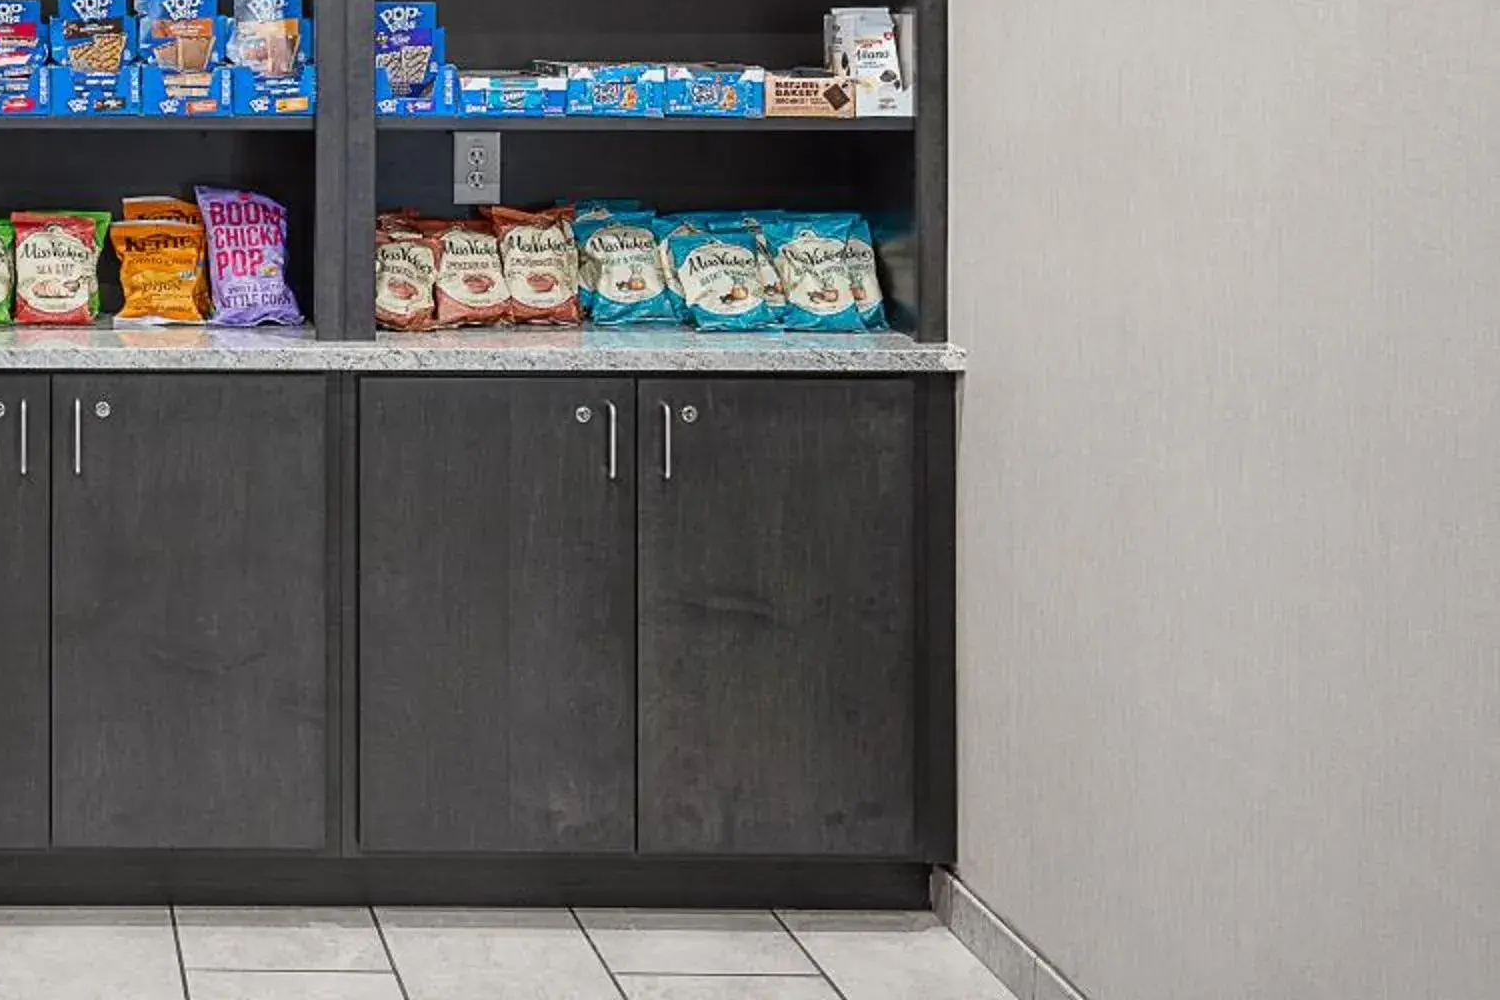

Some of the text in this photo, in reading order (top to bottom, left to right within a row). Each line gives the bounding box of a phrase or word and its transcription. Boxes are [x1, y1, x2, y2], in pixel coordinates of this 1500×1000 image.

[210, 201, 284, 226] BOOM
[214, 225, 285, 249] CHICKA
[216, 248, 263, 280] POP
